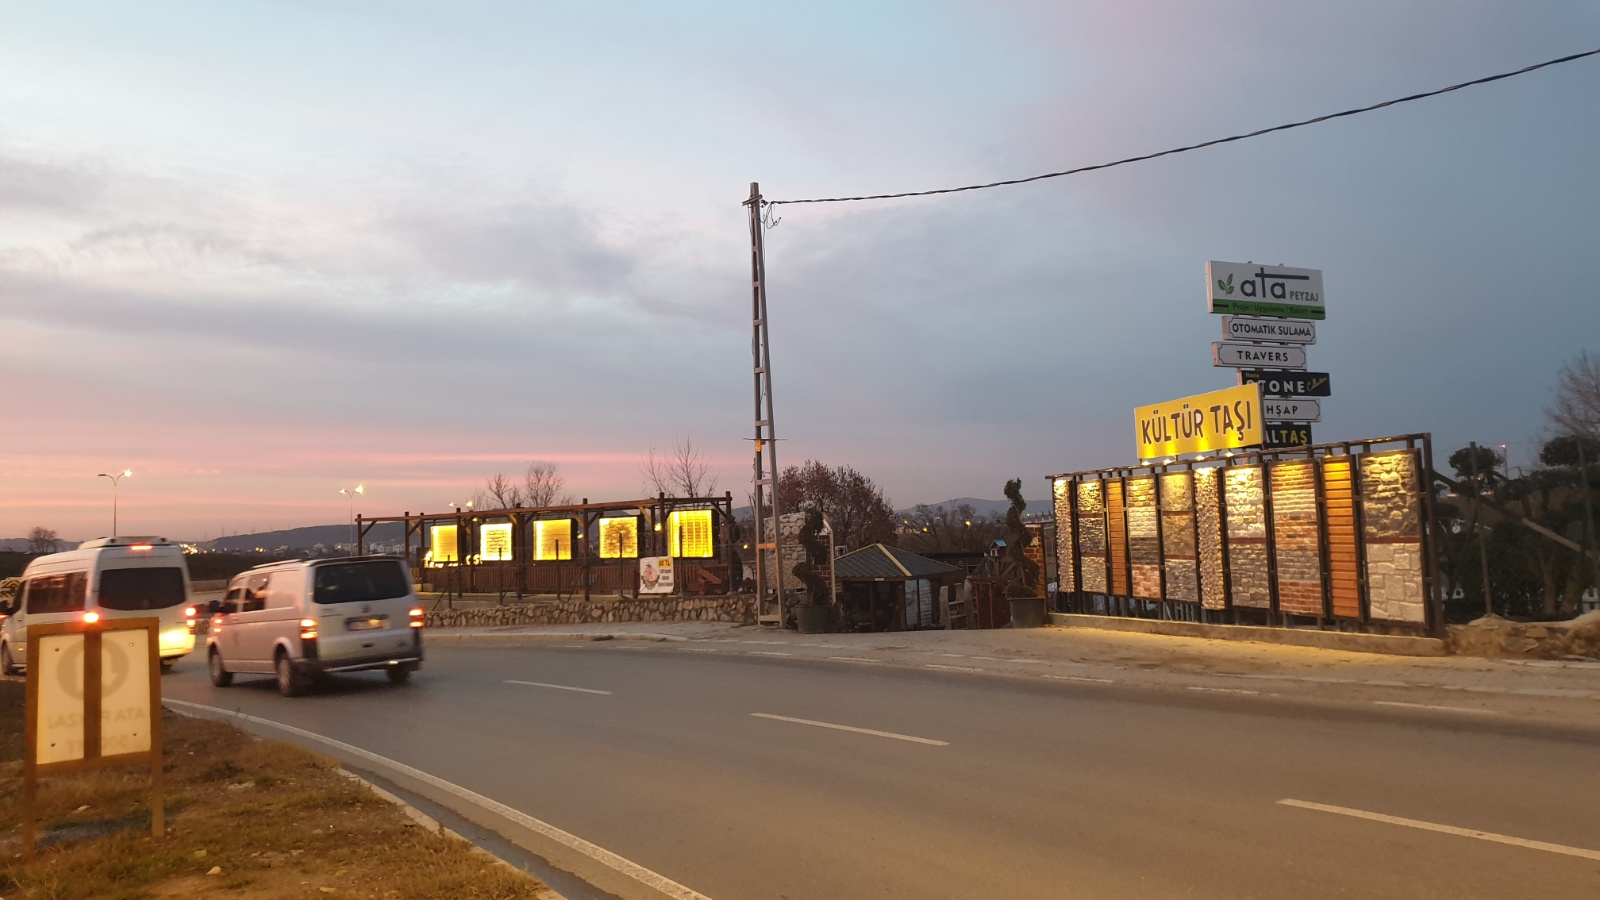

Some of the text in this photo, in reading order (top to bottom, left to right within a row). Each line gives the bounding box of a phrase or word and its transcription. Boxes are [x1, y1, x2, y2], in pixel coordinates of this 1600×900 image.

[1290, 291, 1319, 302] PEYZAJ
[1232, 323, 1311, 337] OTOMATİK SULAMA
[1237, 350, 1288, 362] TRAVERS
[1267, 405, 1298, 417] HŞAP
[1141, 400, 1251, 445] KÜLTÜR TAŞI
